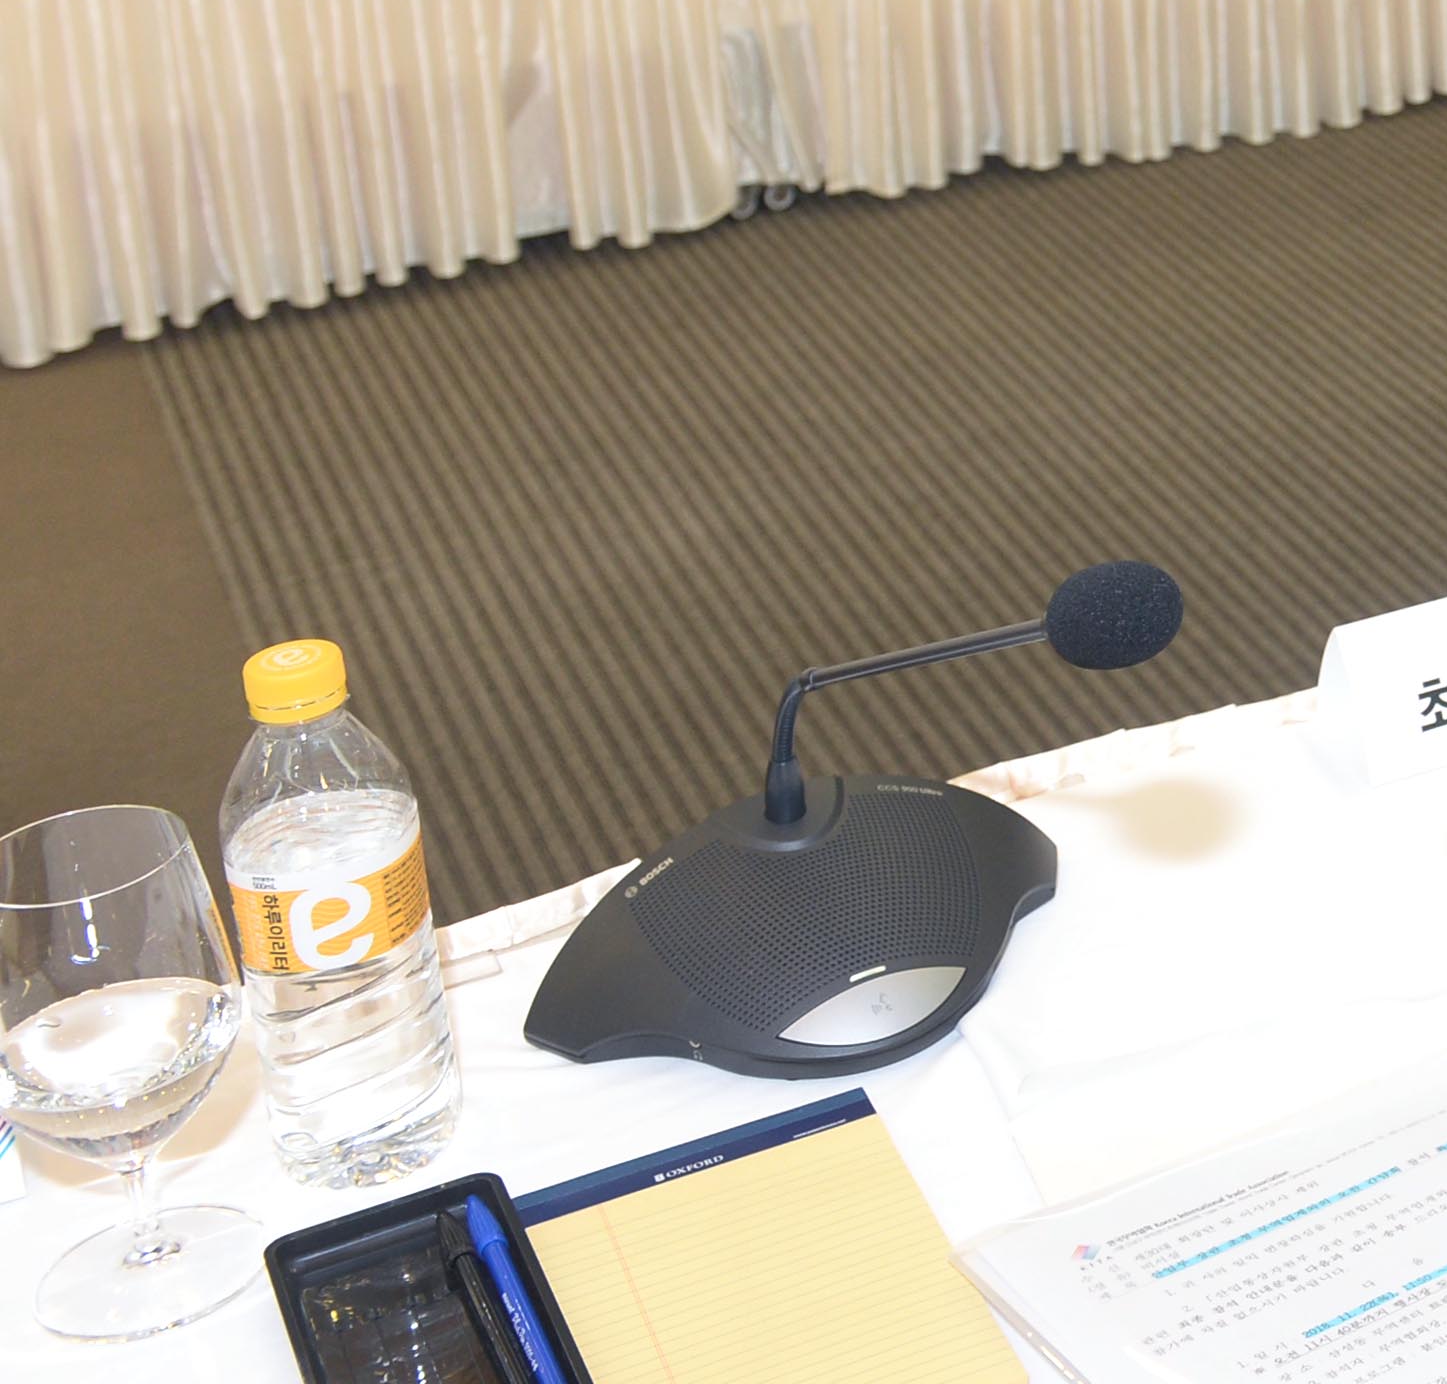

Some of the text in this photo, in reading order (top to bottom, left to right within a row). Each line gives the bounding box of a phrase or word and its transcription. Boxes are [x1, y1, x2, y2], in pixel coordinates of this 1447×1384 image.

[639, 857, 674, 886] BOSCH
[261, 893, 290, 972] 하루이리터
[287, 880, 376, 972] e
[665, 1153, 725, 1179] OXFORD
[1300, 1320, 1335, 1339] 2018.
